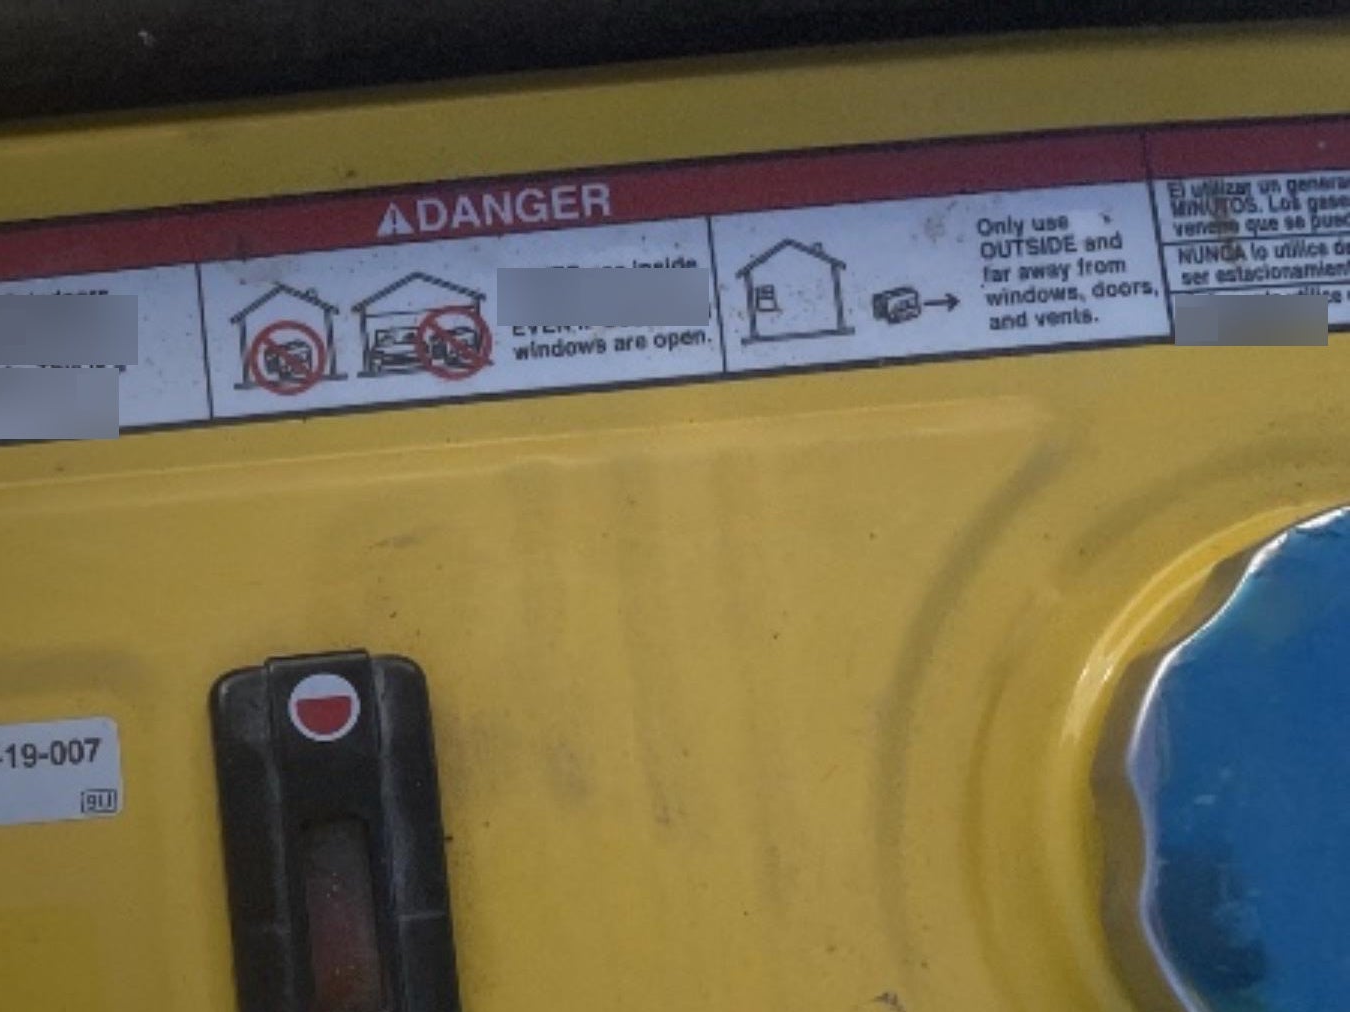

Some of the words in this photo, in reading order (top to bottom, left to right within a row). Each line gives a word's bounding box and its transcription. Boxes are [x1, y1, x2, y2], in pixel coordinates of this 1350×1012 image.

[416, 182, 613, 233] DANGER
[977, 215, 1024, 237] Only
[1032, 214, 1070, 232] use
[980, 234, 1078, 259] OUTSIDE
[1084, 230, 1123, 251] and
[1178, 243, 1247, 265] NUNCA
[983, 264, 1011, 283] far
[1018, 262, 1071, 282] away
[1077, 257, 1126, 277] from
[985, 284, 1086, 306] windows,
[1091, 280, 1159, 298] doors,
[989, 310, 1028, 331] and
[1035, 307, 1099, 327] vents.
[514, 338, 607, 361] windows
[614, 334, 648, 352] are
[653, 329, 712, 352] open.
